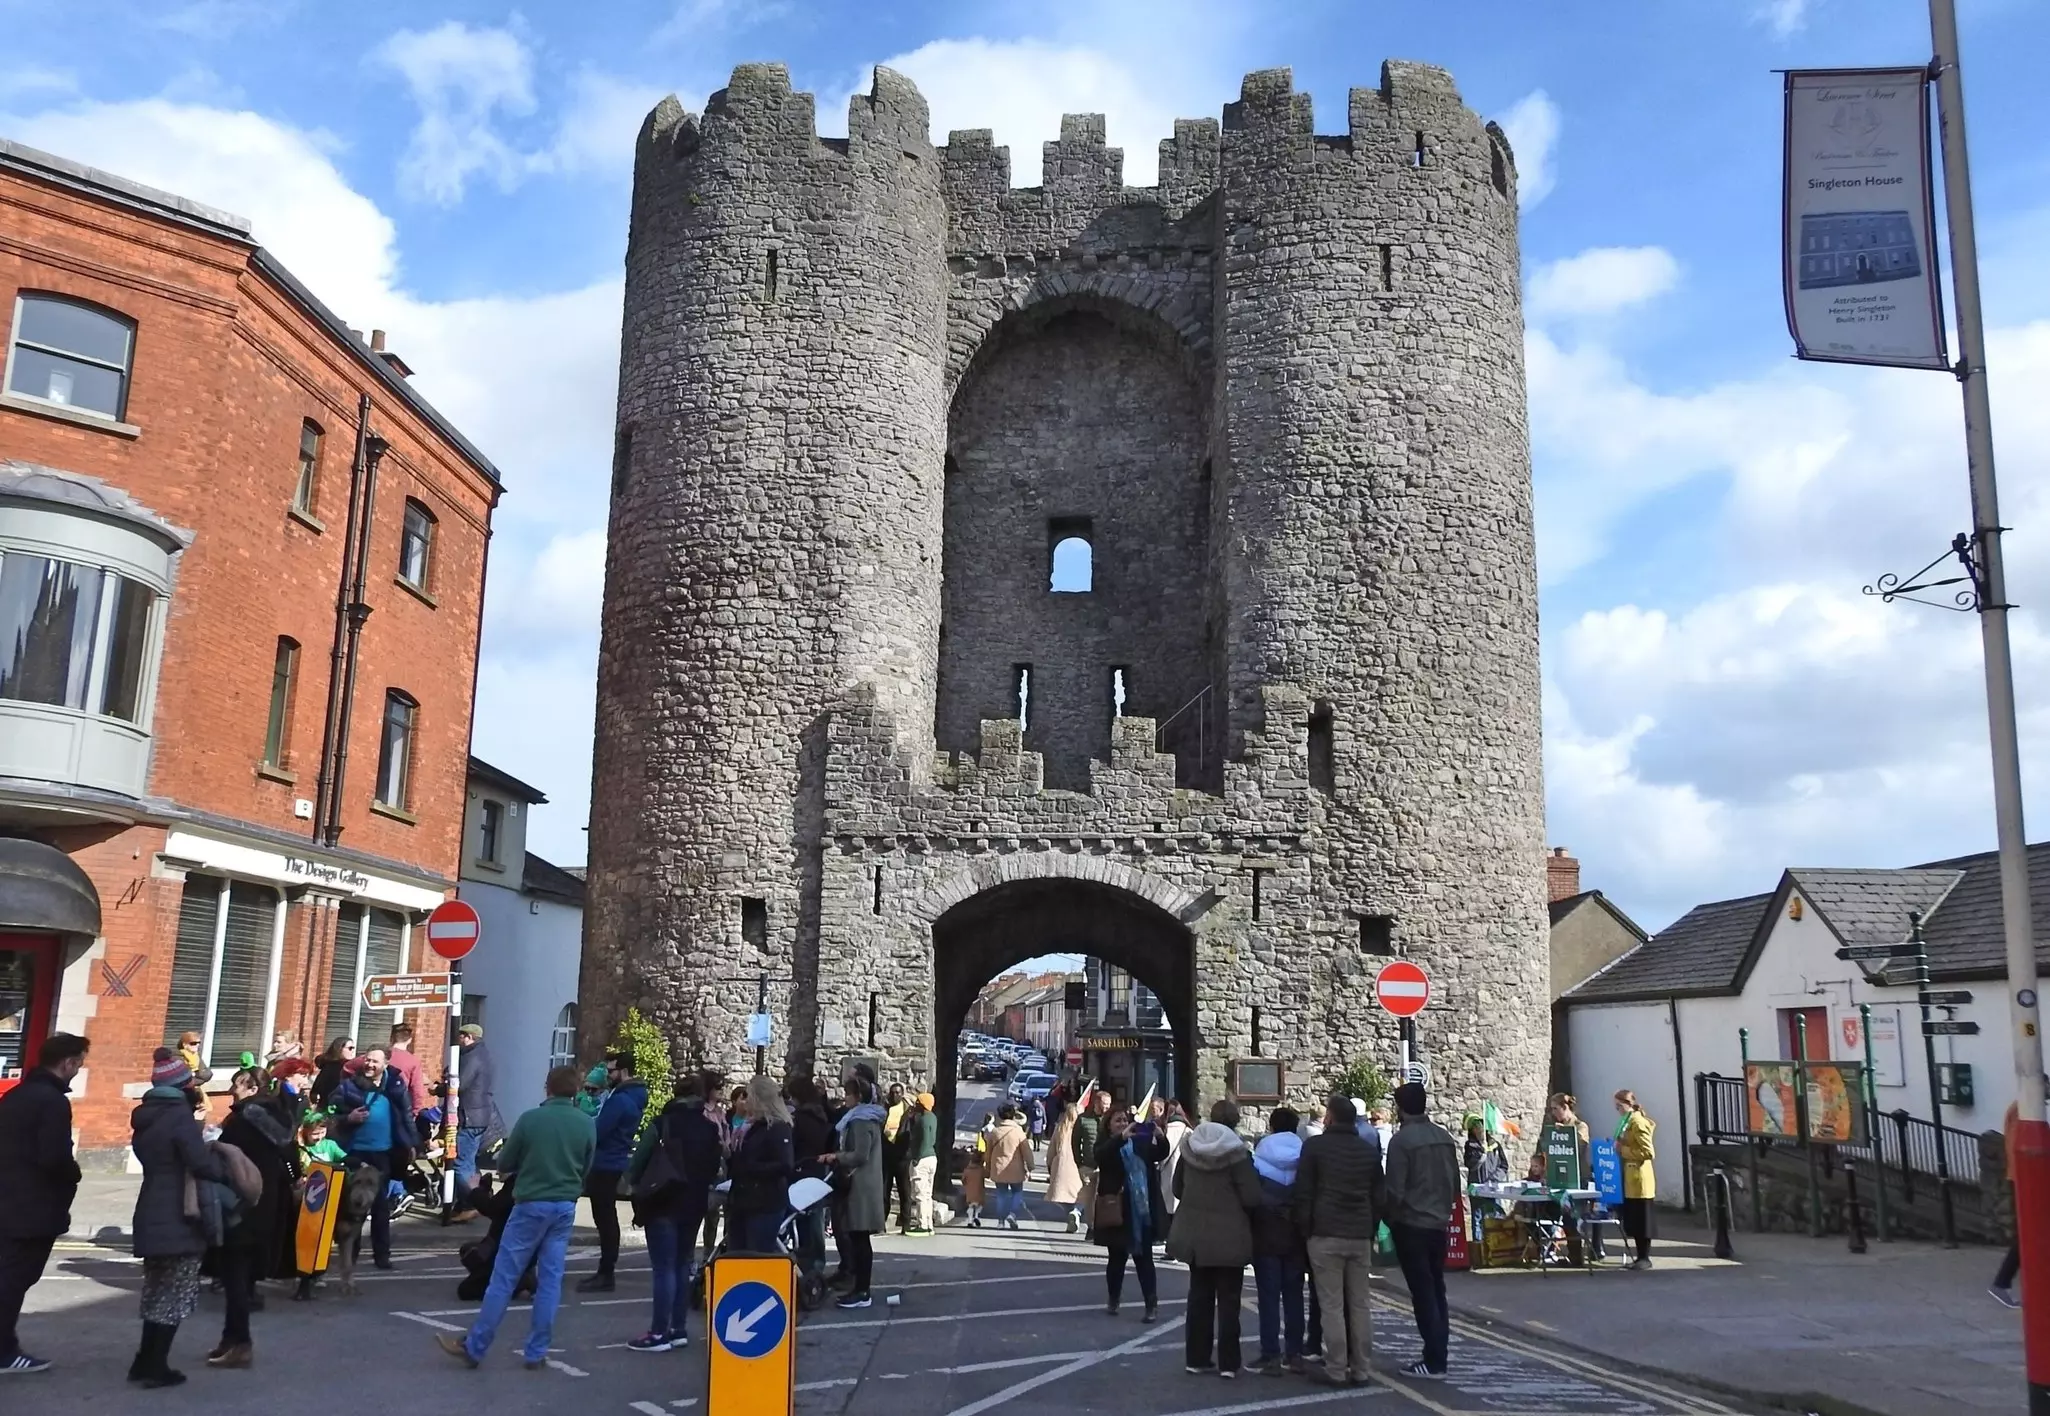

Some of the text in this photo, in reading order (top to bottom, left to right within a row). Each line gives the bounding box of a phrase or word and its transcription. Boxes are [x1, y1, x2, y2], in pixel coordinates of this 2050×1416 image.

[1808, 176, 1904, 191] Singleton House
[1833, 295, 1877, 305] Attributed
[1857, 304, 1896, 314] Singleton
[1836, 316, 1856, 324] Built
[285, 856, 369, 892] The Design Gallery
[1087, 1038, 1139, 1048] SARSFIELDS
[1551, 1131, 1569, 1141] Free
[1548, 1144, 1574, 1156] Bibles
[1597, 1145, 1610, 1155] Can
[1598, 1158, 1615, 1170] Pray
[1602, 1170, 1613, 1182] for
[1601, 1184, 1617, 1193] You?
